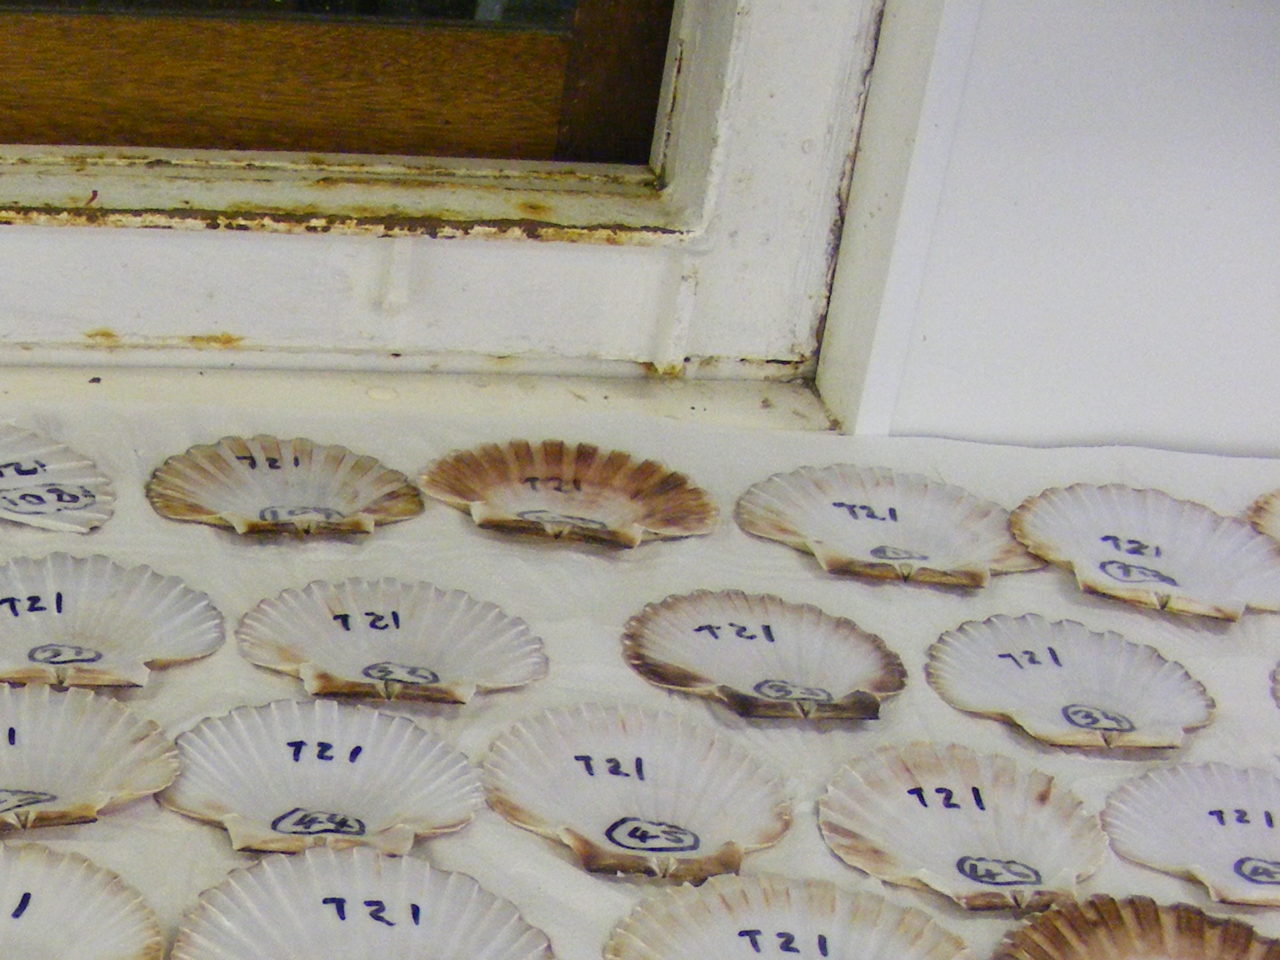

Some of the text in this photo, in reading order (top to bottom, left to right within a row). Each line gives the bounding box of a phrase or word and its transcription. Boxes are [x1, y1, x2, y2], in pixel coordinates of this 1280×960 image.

[235, 454, 300, 470] T21
[832, 501, 898, 522] T21
[332, 610, 400, 631] T21
[693, 621, 776, 643] T21
[997, 646, 1063, 670] T21
[286, 740, 363, 764] T21
[573, 754, 646, 782] T21
[906, 785, 987, 812] T21
[1207, 807, 1276, 830] T21
[321, 896, 421, 927] T21
[737, 928, 829, 957] T21
